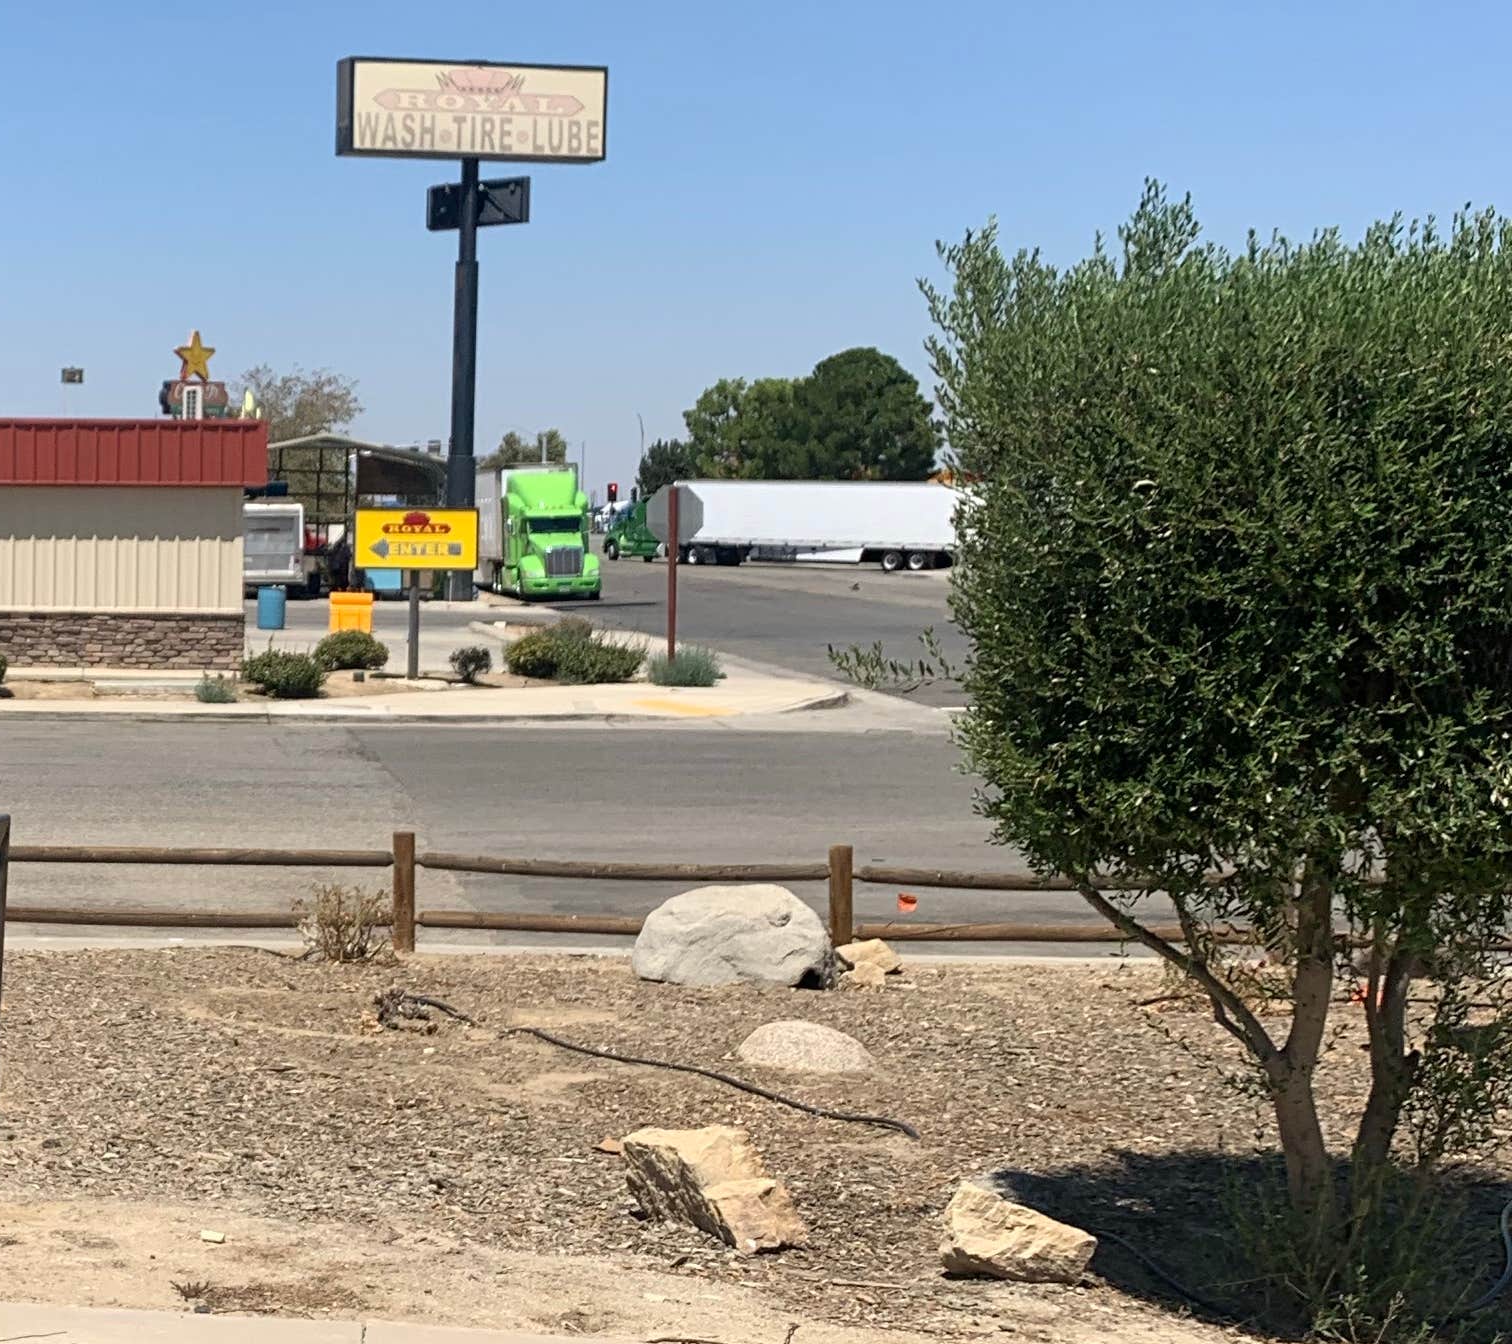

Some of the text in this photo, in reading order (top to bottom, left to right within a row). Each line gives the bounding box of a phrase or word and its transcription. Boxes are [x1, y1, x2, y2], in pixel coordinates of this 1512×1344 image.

[397, 92, 565, 115] ROYAL
[357, 111, 600, 155] WASH TIRE LUBE
[388, 524, 446, 534] ROYAL
[389, 542, 449, 556] ENTER
